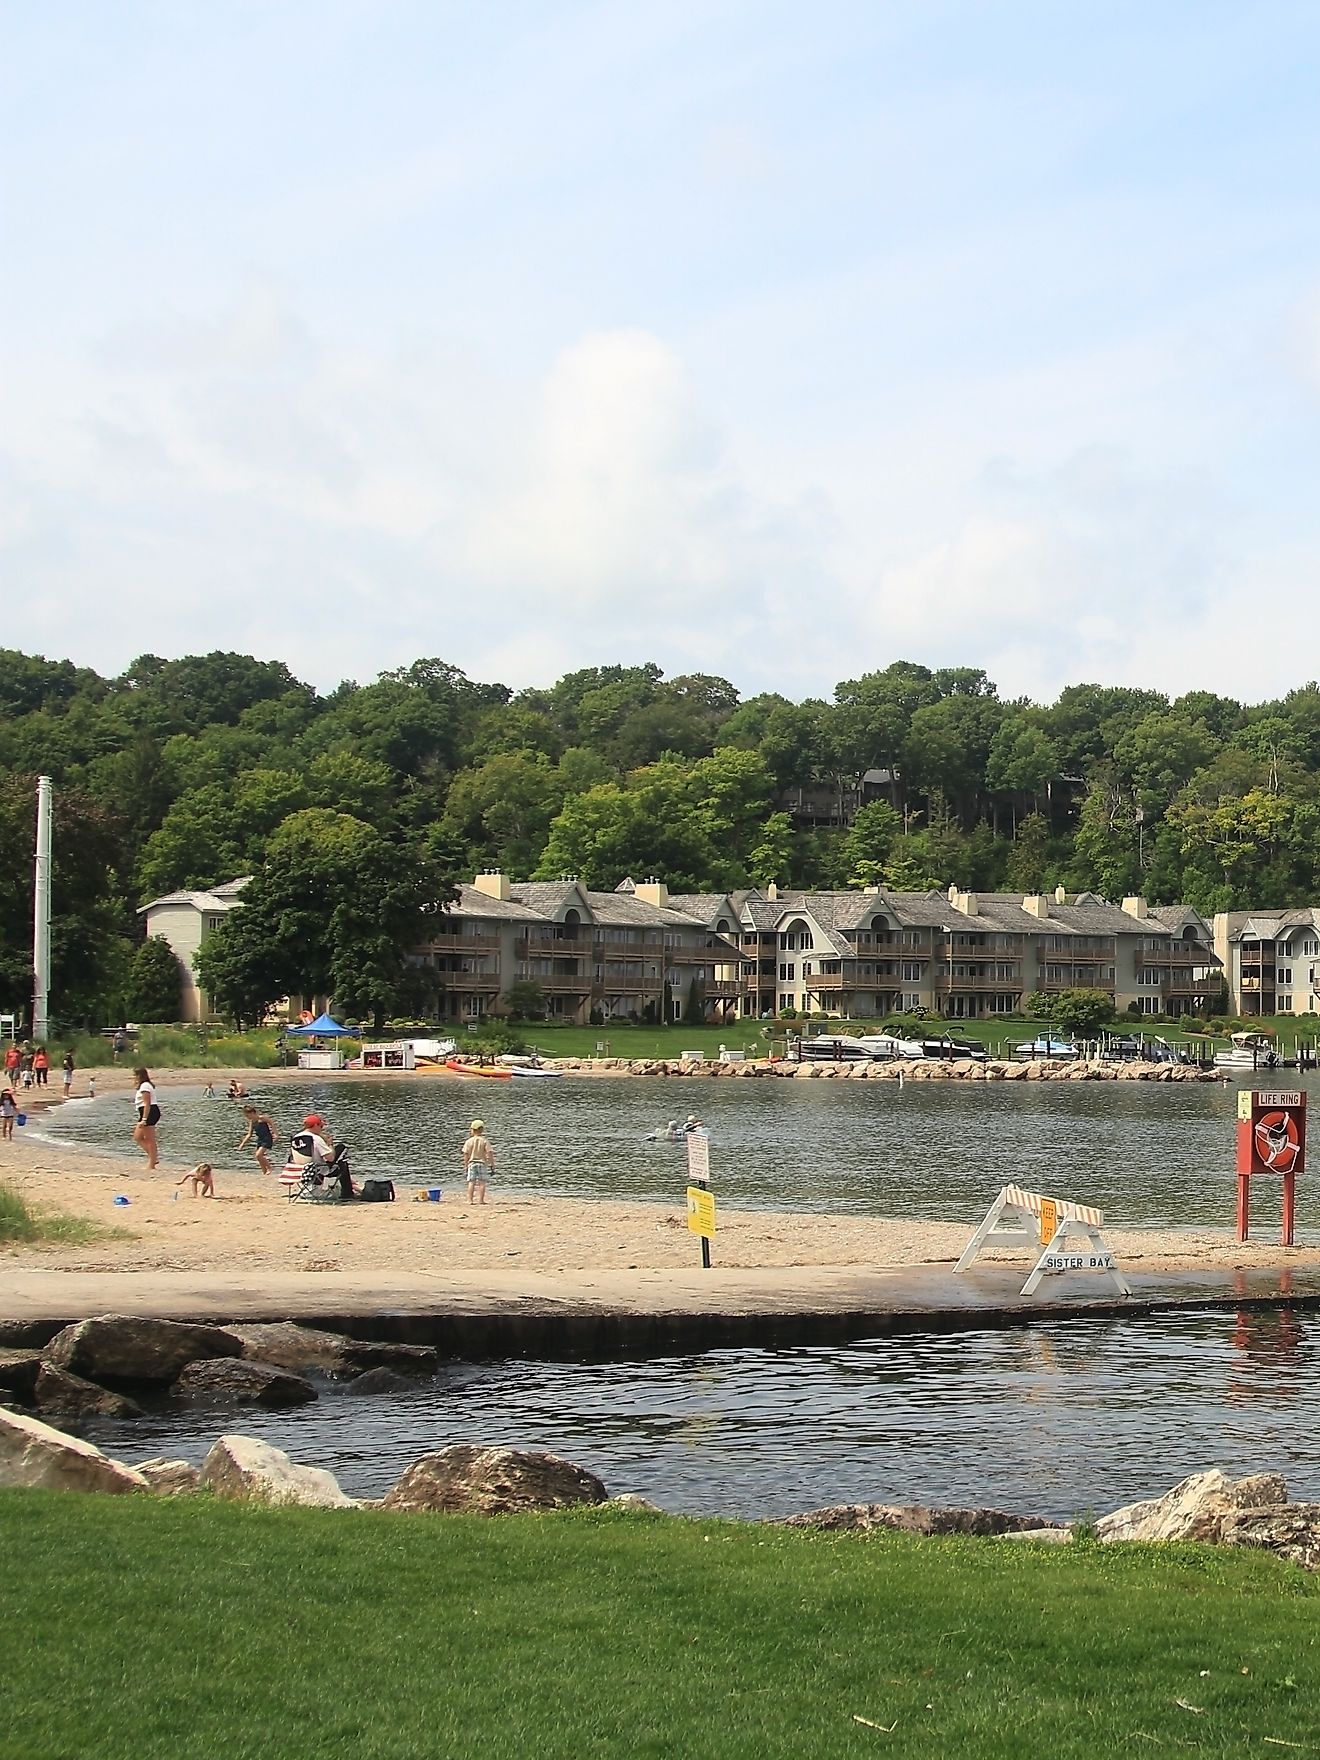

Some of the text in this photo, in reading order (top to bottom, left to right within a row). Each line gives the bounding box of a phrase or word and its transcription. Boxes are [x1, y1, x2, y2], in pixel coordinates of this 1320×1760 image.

[1261, 1094, 1299, 1104] LIFE RING
[1043, 1207, 1054, 1219] KEEP
[1047, 1257, 1110, 1267] SISTER BAY
